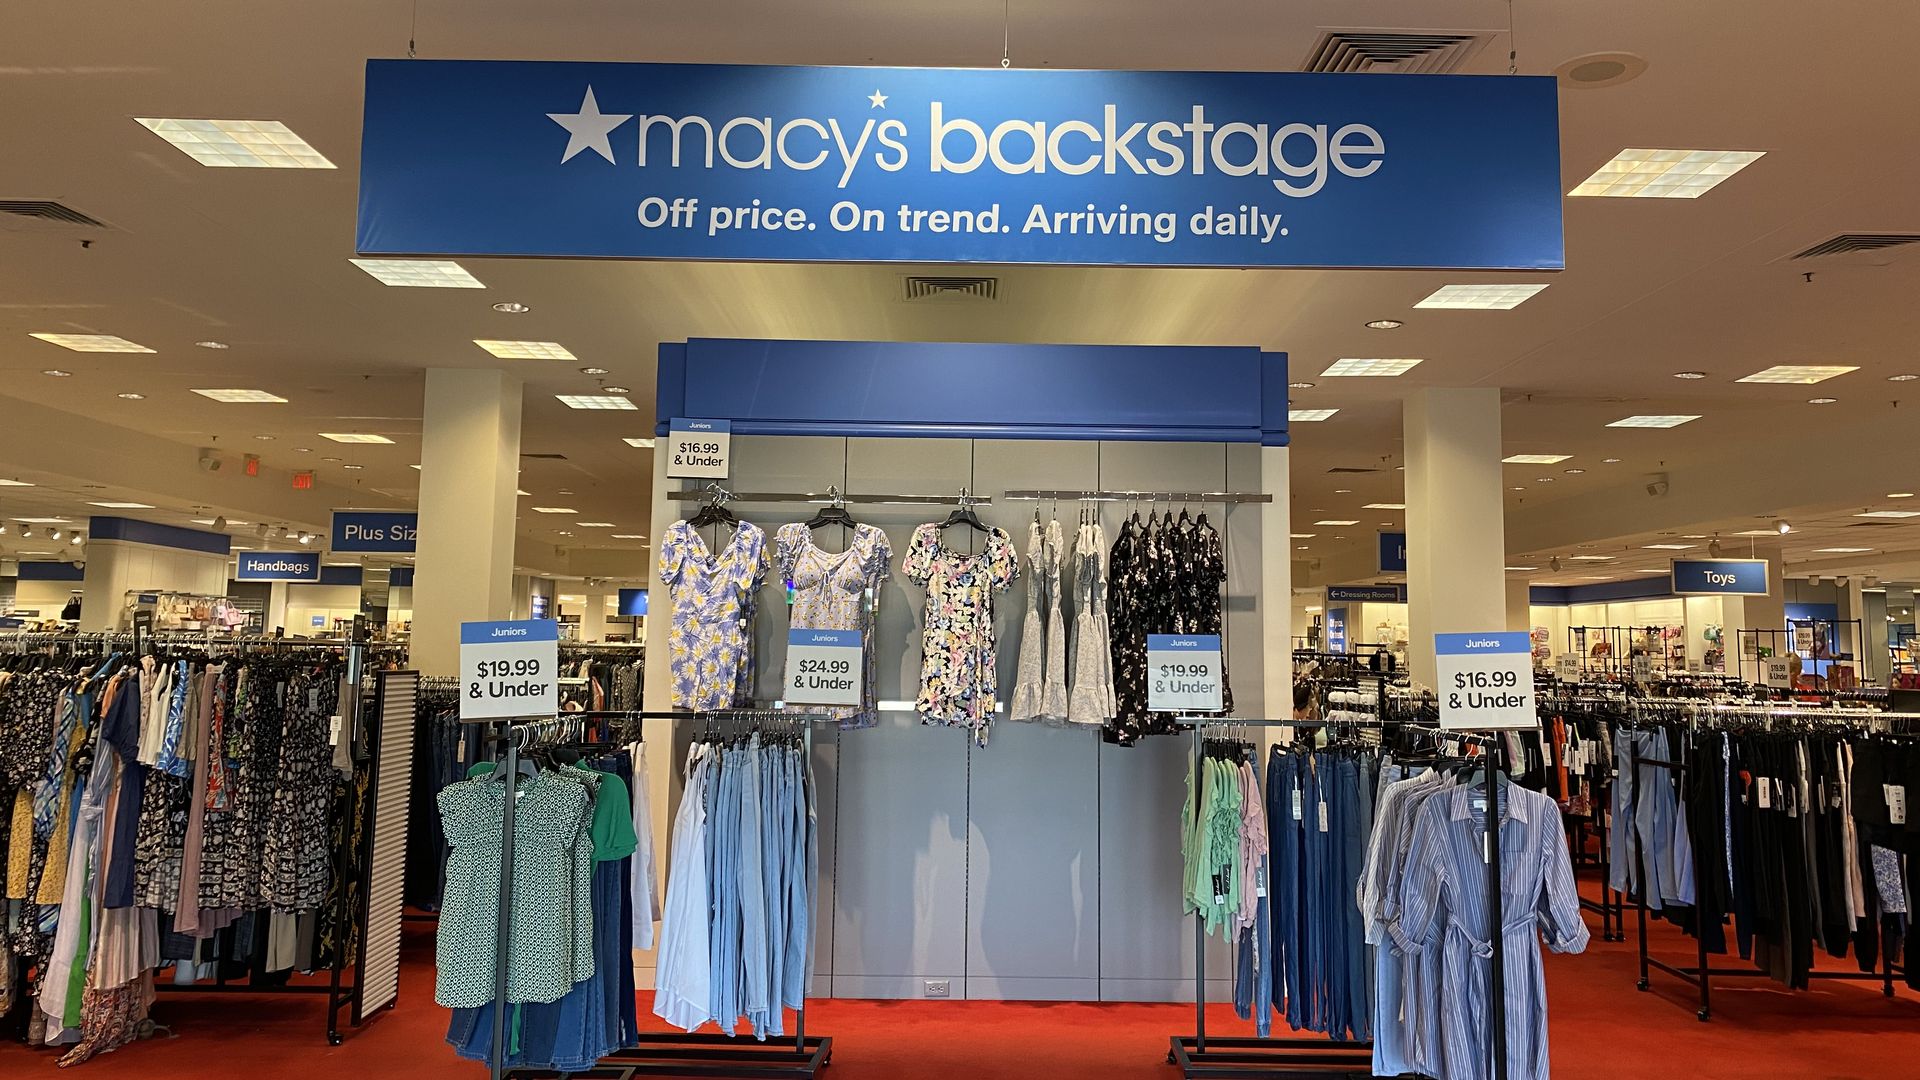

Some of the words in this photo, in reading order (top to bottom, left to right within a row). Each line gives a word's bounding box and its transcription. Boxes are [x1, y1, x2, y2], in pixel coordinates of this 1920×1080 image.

[930, 101, 1386, 198] backstage
[637, 197, 698, 229] Off
[708, 199, 817, 237] price.
[829, 201, 885, 233] On
[898, 204, 1011, 234] trend.
[1022, 204, 1177, 244] Arriving
[1190, 206, 1290, 244] daily.
[679, 442, 719, 454] $16.99
[674, 454, 683, 465] &
[686, 455, 724, 467] Under
[344, 524, 384, 540] Plus
[247, 560, 310, 575] Handbags
[1703, 570, 1736, 587] Toys
[1340, 591, 1371, 600] Dressing
[491, 627, 528, 637] Juniors
[811, 634, 839, 642] Juniors
[1170, 639, 1198, 647] Juniors
[1465, 638, 1500, 648] Juniors
[477, 659, 540, 679] $19.99
[799, 659, 850, 674] $24.99
[1160, 663, 1208, 678] $19.99
[794, 675, 805, 689] &
[809, 675, 854, 690] Under
[1155, 680, 1166, 693] &
[1170, 680, 1215, 693] Under
[1454, 671, 1517, 690] $16.99
[469, 682, 483, 699] &
[489, 680, 549, 698] Under
[1448, 692, 1462, 709] &
[1467, 692, 1526, 709] Under
